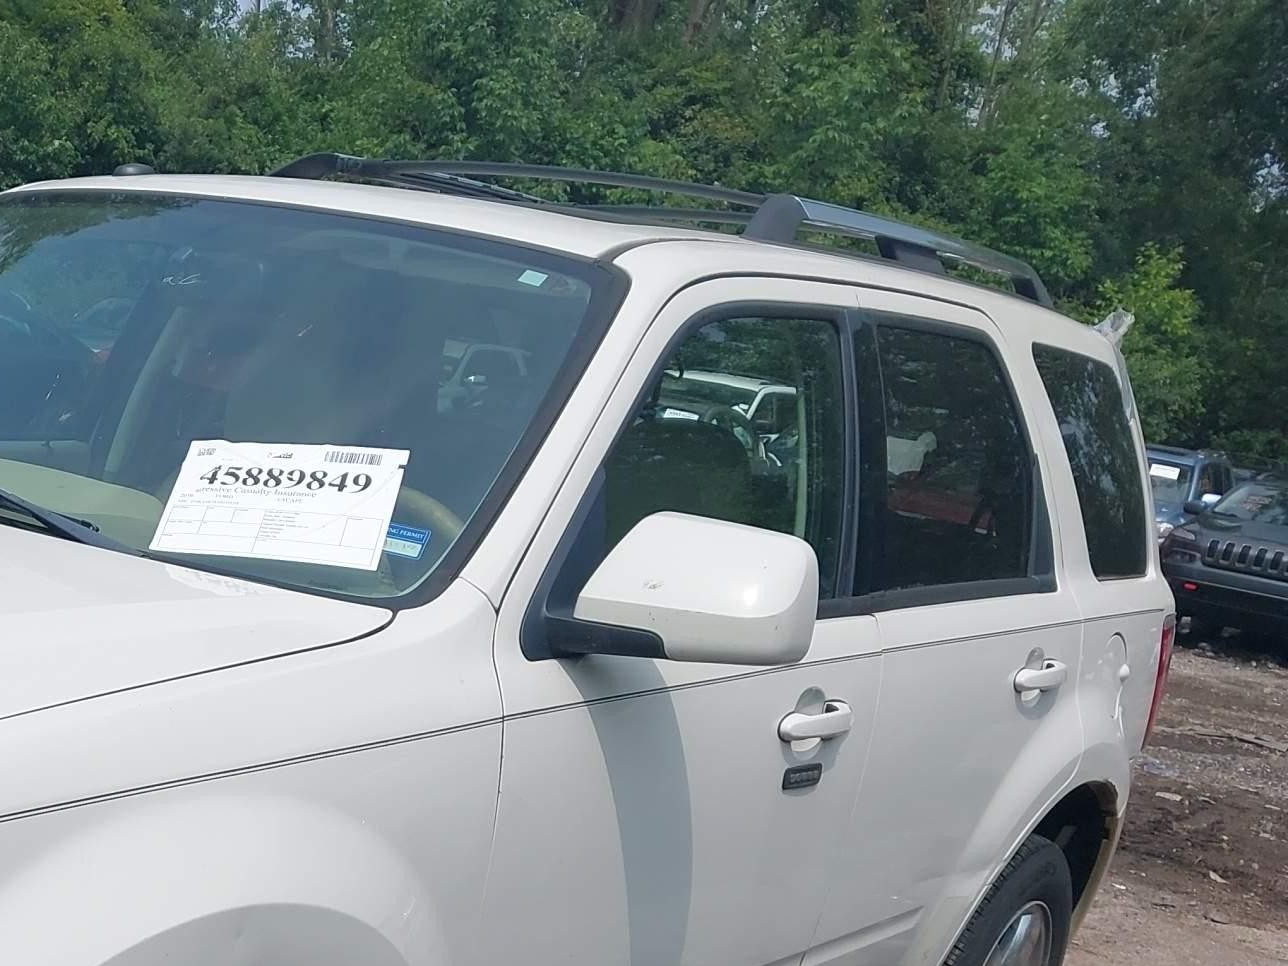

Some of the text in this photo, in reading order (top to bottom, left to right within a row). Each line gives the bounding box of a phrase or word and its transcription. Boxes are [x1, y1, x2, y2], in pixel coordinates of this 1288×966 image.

[199, 464, 372, 493] 45889849
[234, 487, 272, 497] Casualty
[274, 488, 317, 498] Insurance
[399, 529, 425, 539] PERMIT
